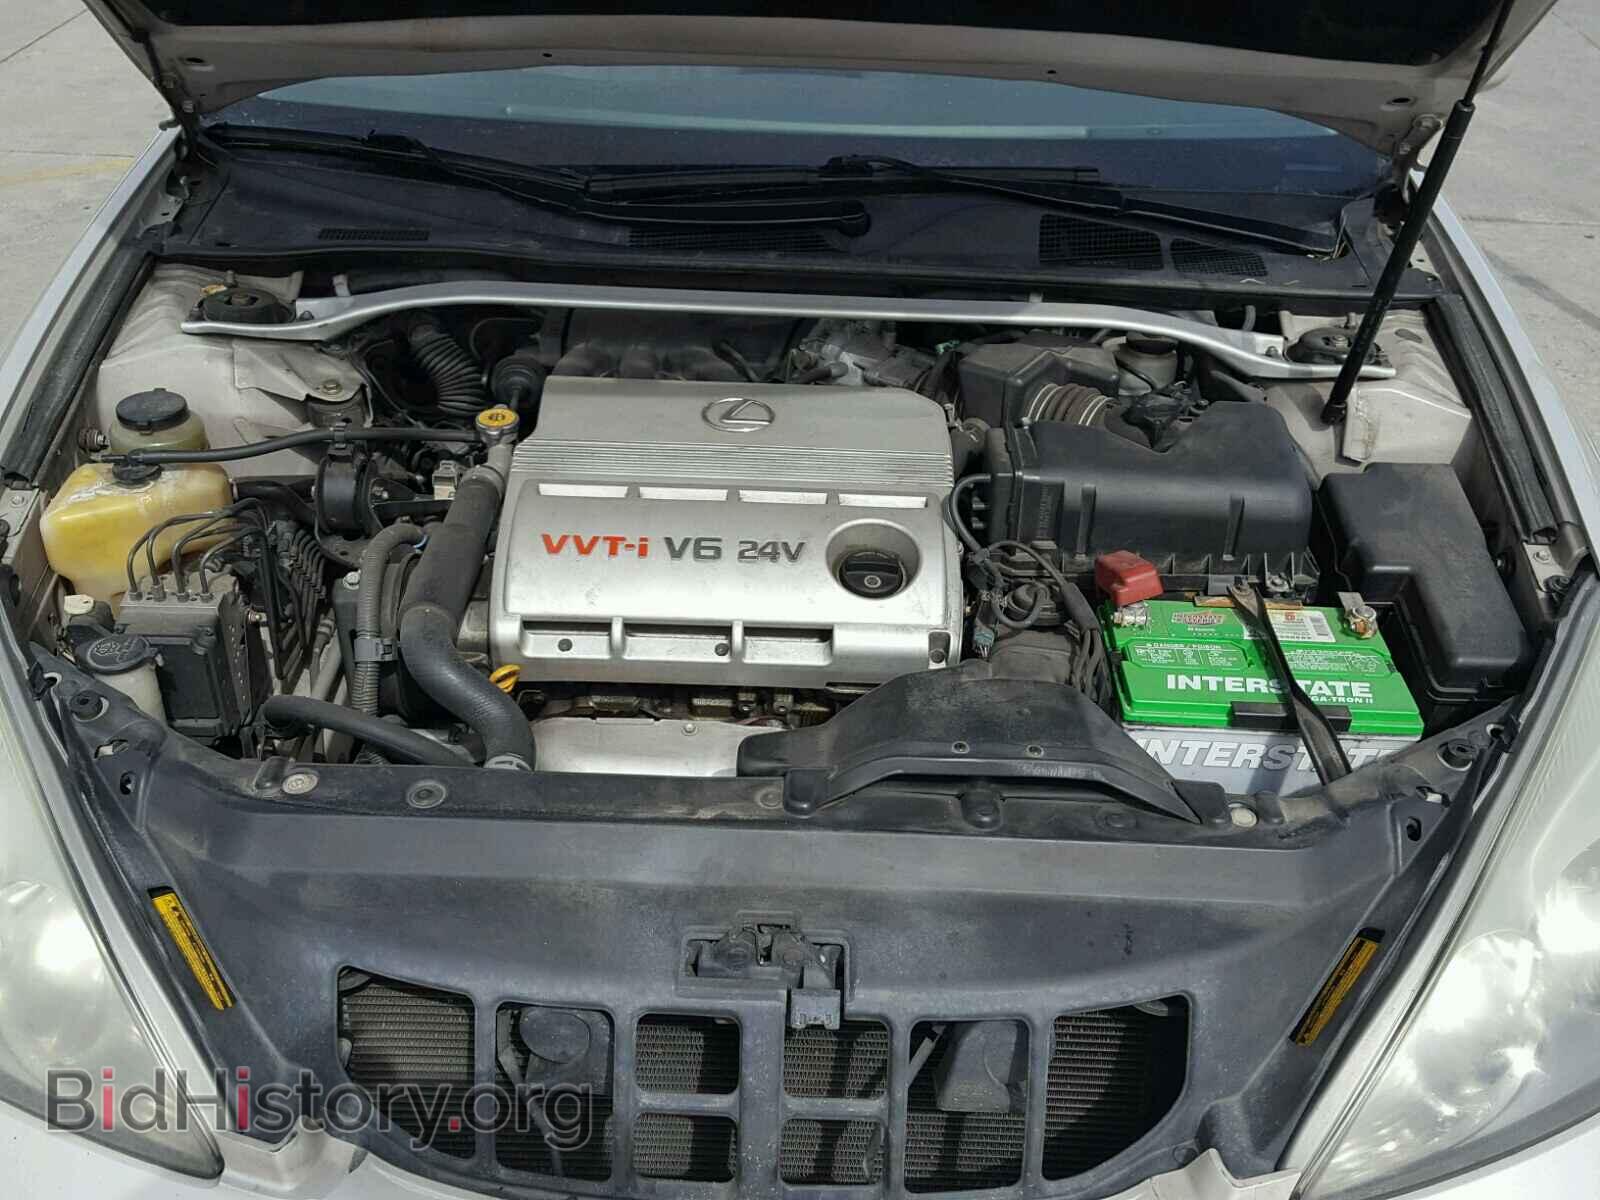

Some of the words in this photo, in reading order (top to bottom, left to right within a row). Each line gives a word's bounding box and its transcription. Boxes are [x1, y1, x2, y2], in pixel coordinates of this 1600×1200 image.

[541, 533, 649, 559] VVT-i
[663, 536, 723, 562] V6
[736, 539, 806, 563] 24V
[1309, 695, 1362, 704] GA-TRON
